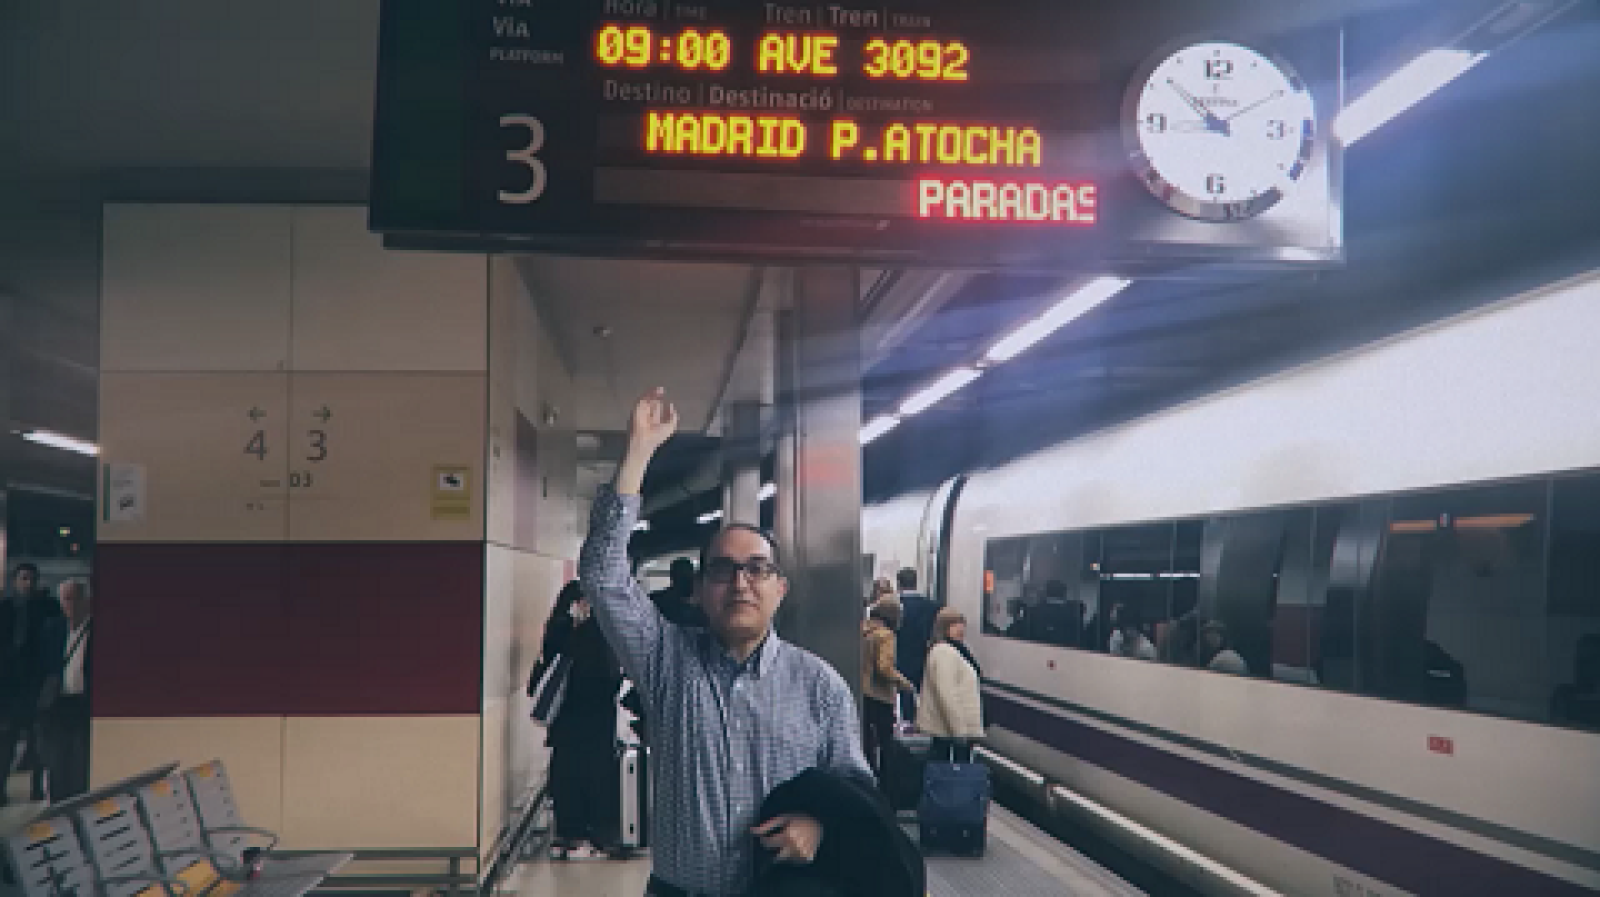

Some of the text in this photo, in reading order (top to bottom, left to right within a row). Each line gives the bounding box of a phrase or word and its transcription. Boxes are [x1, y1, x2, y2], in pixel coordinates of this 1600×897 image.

[765, 4, 810, 23] Tren
[830, 7, 877, 27] Tren
[598, 26, 968, 80] 09:00 AVE 3092
[1204, 59, 1233, 80] 12
[604, 80, 690, 102] Destino
[709, 85, 831, 109] Destinació
[1147, 113, 1167, 134] 9
[1266, 119, 1286, 140] 3
[648, 112, 1042, 166] MADRID P.ATOCHA
[498, 115, 547, 204] 3
[1206, 173, 1227, 194] 6
[243, 430, 328, 462] 4 3
